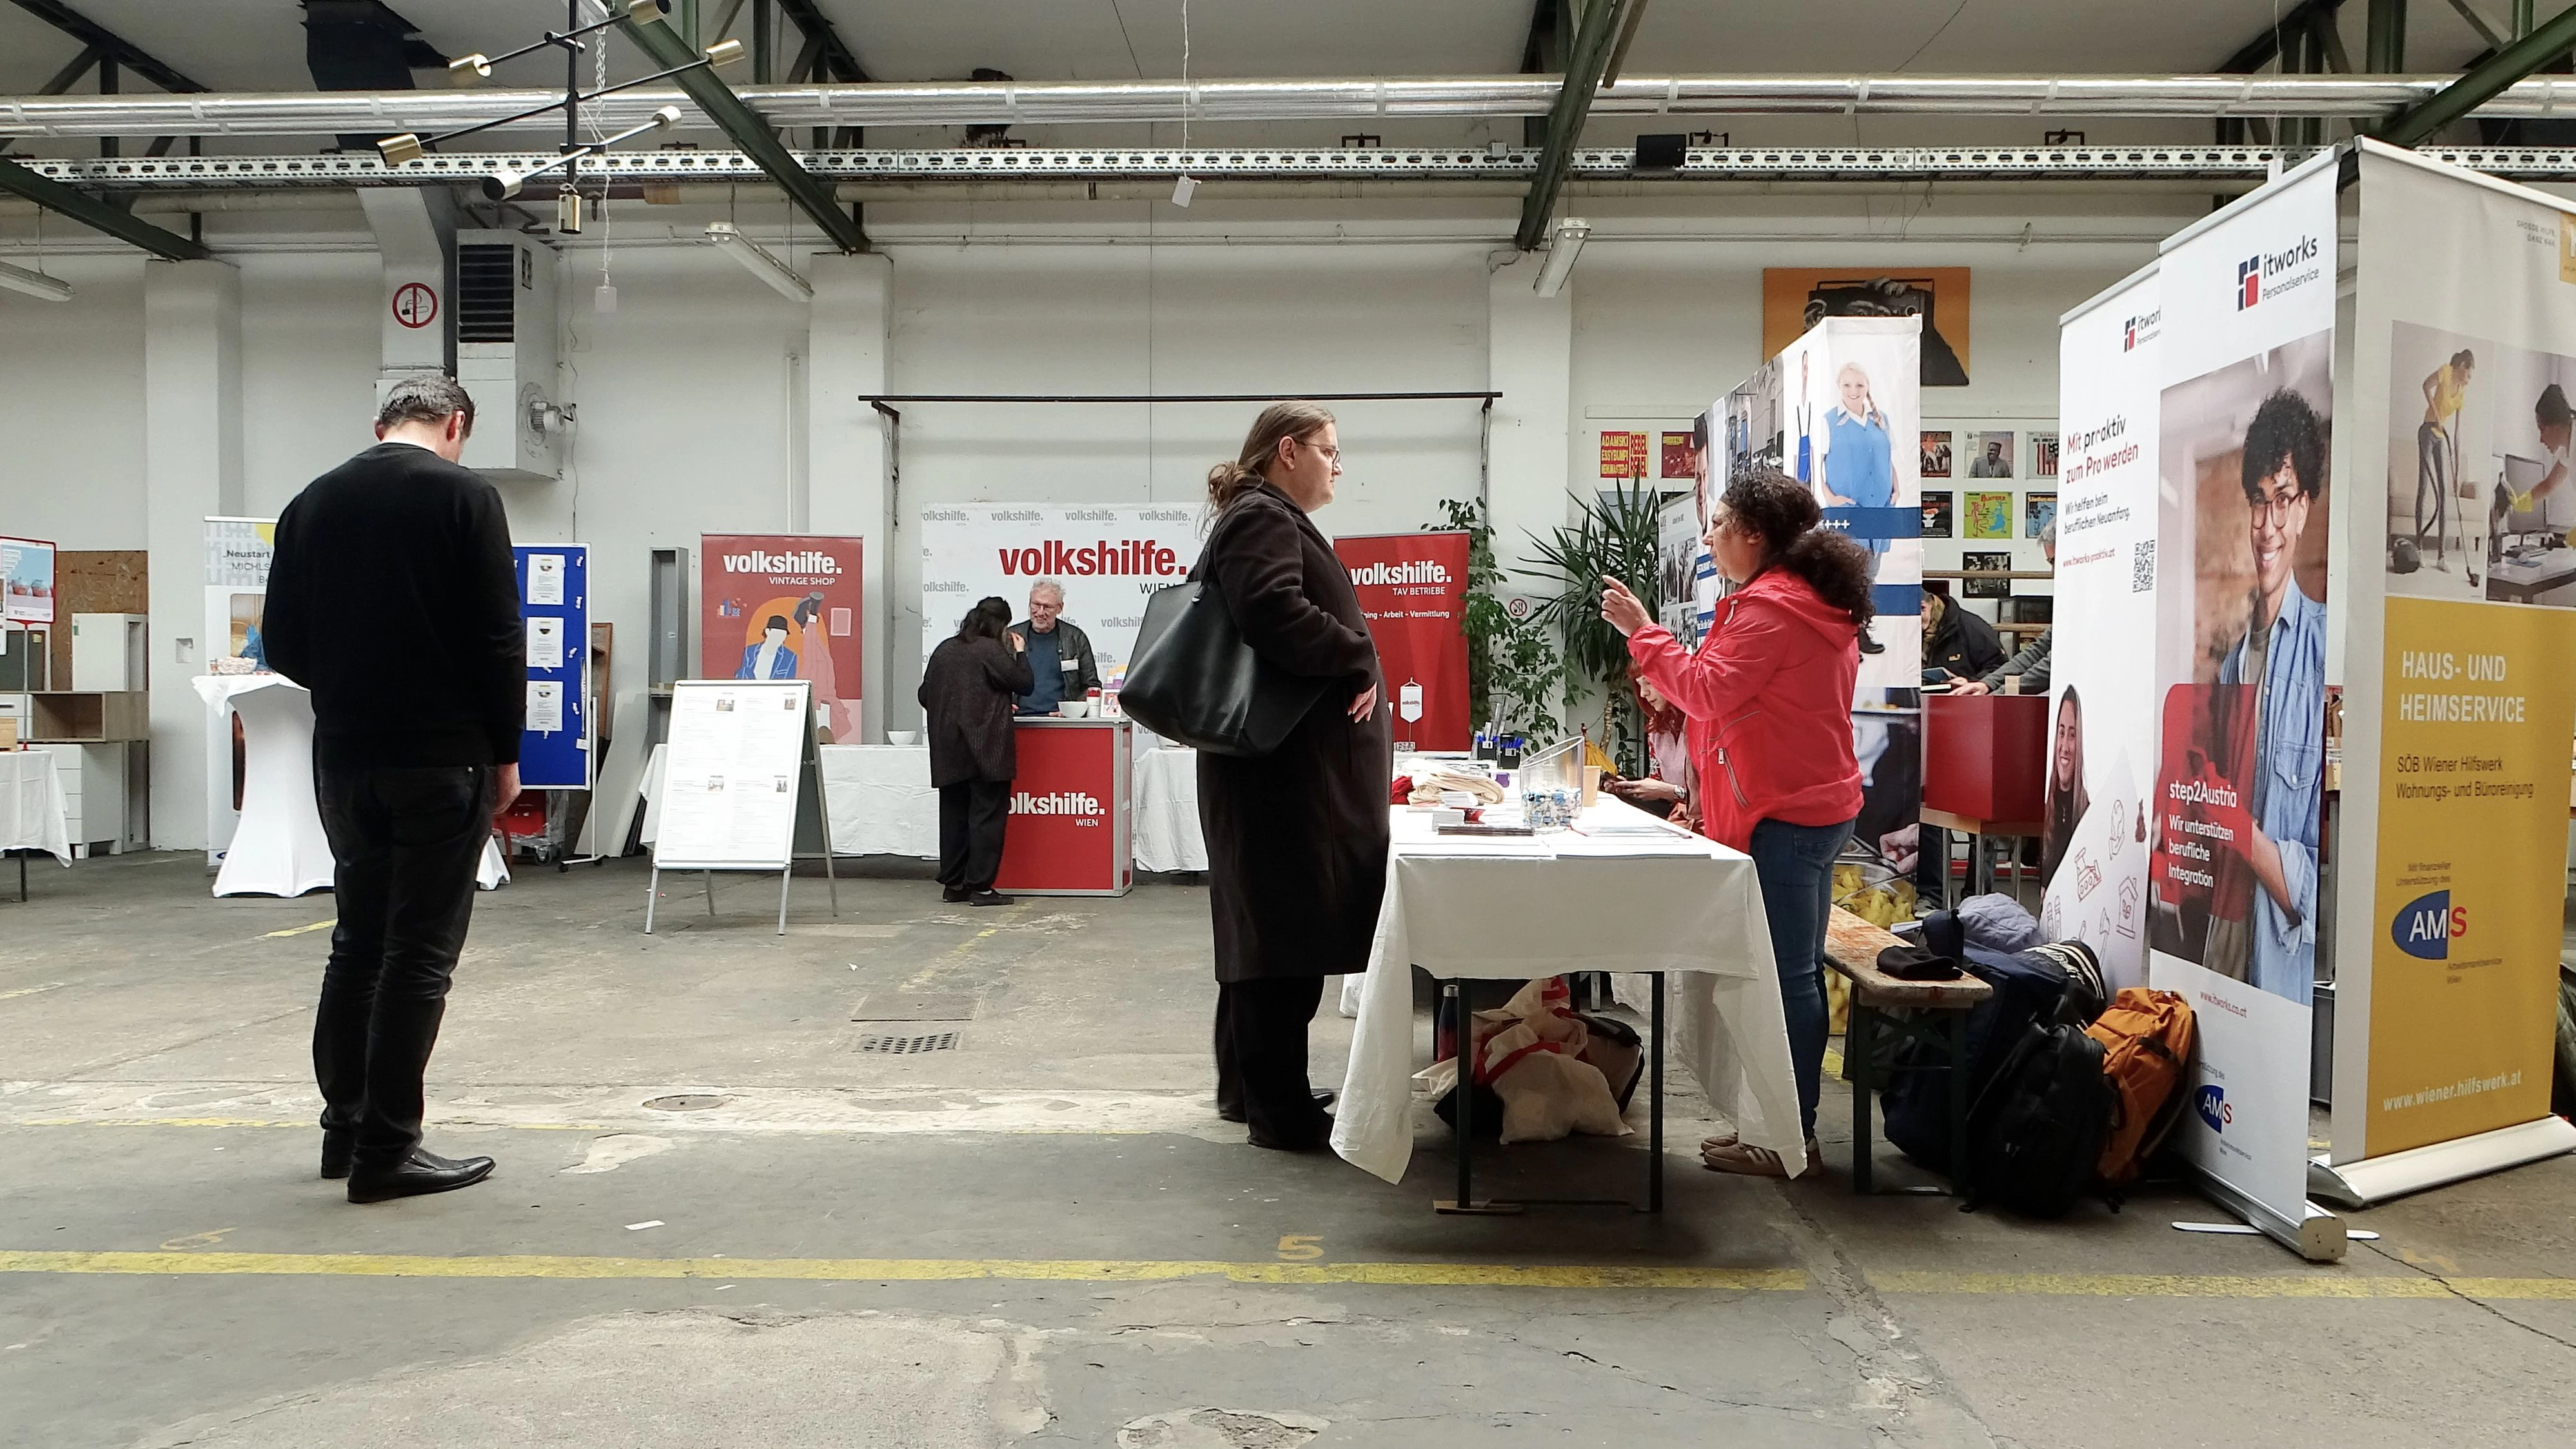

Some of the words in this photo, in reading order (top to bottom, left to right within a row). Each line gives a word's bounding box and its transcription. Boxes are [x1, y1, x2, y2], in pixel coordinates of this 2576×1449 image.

[2263, 235, 2317, 279] itworks
[2262, 269, 2319, 301] Personalservice
[2138, 304, 2161, 332] itwor
[2067, 431, 2081, 455] Mit
[2065, 464, 2083, 484] zum
[2086, 455, 2102, 478] Pro
[2103, 442, 2139, 471] werden
[991, 510, 1044, 521] volkshilfe.
[1065, 509, 1117, 521] volkshilfe.
[1139, 510, 1192, 521] volkshilfe.
[723, 550, 843, 575] volkshilfe.
[999, 540, 1187, 575] volkshilfe.
[769, 577, 809, 586] VINTAGE
[810, 577, 836, 586] SHOP
[1350, 560, 1452, 586] volkshilfe.
[923, 582, 970, 593] olkshilfe.
[1393, 587, 1408, 596] TAV
[1410, 586, 1446, 595] BETRIEBE
[1101, 617, 1144, 627] volkshil
[1410, 609, 1450, 619] Vermittlung
[2401, 650, 2462, 680] HAUS-
[2467, 654, 2506, 682] UND
[2399, 693, 2526, 723] HEIMSERVICE
[2397, 753, 2419, 773] SÖB
[2423, 755, 2458, 773] Wiener
[2461, 755, 2503, 772] Hilfswerk
[2169, 780, 2237, 808] step2Austria
[2396, 782, 2451, 802] Wohnungs-
[2454, 782, 2472, 797] und
[2475, 780, 2534, 800] Büroreinigung
[1008, 792, 1105, 815] olkshilfe.
[1075, 818, 1099, 826] WIEN
[2168, 814, 2184, 833] Wir
[2185, 819, 2234, 842] unterstützen
[2168, 838, 2210, 862] berufliche
[2168, 862, 2214, 888] Integration
[2408, 906, 2467, 943] AMS
[2383, 1069, 2522, 1112] www.wiener.hilfswerk.at
[2202, 1093, 2232, 1124] AMS
[1277, 1235, 1324, 1259] 5
